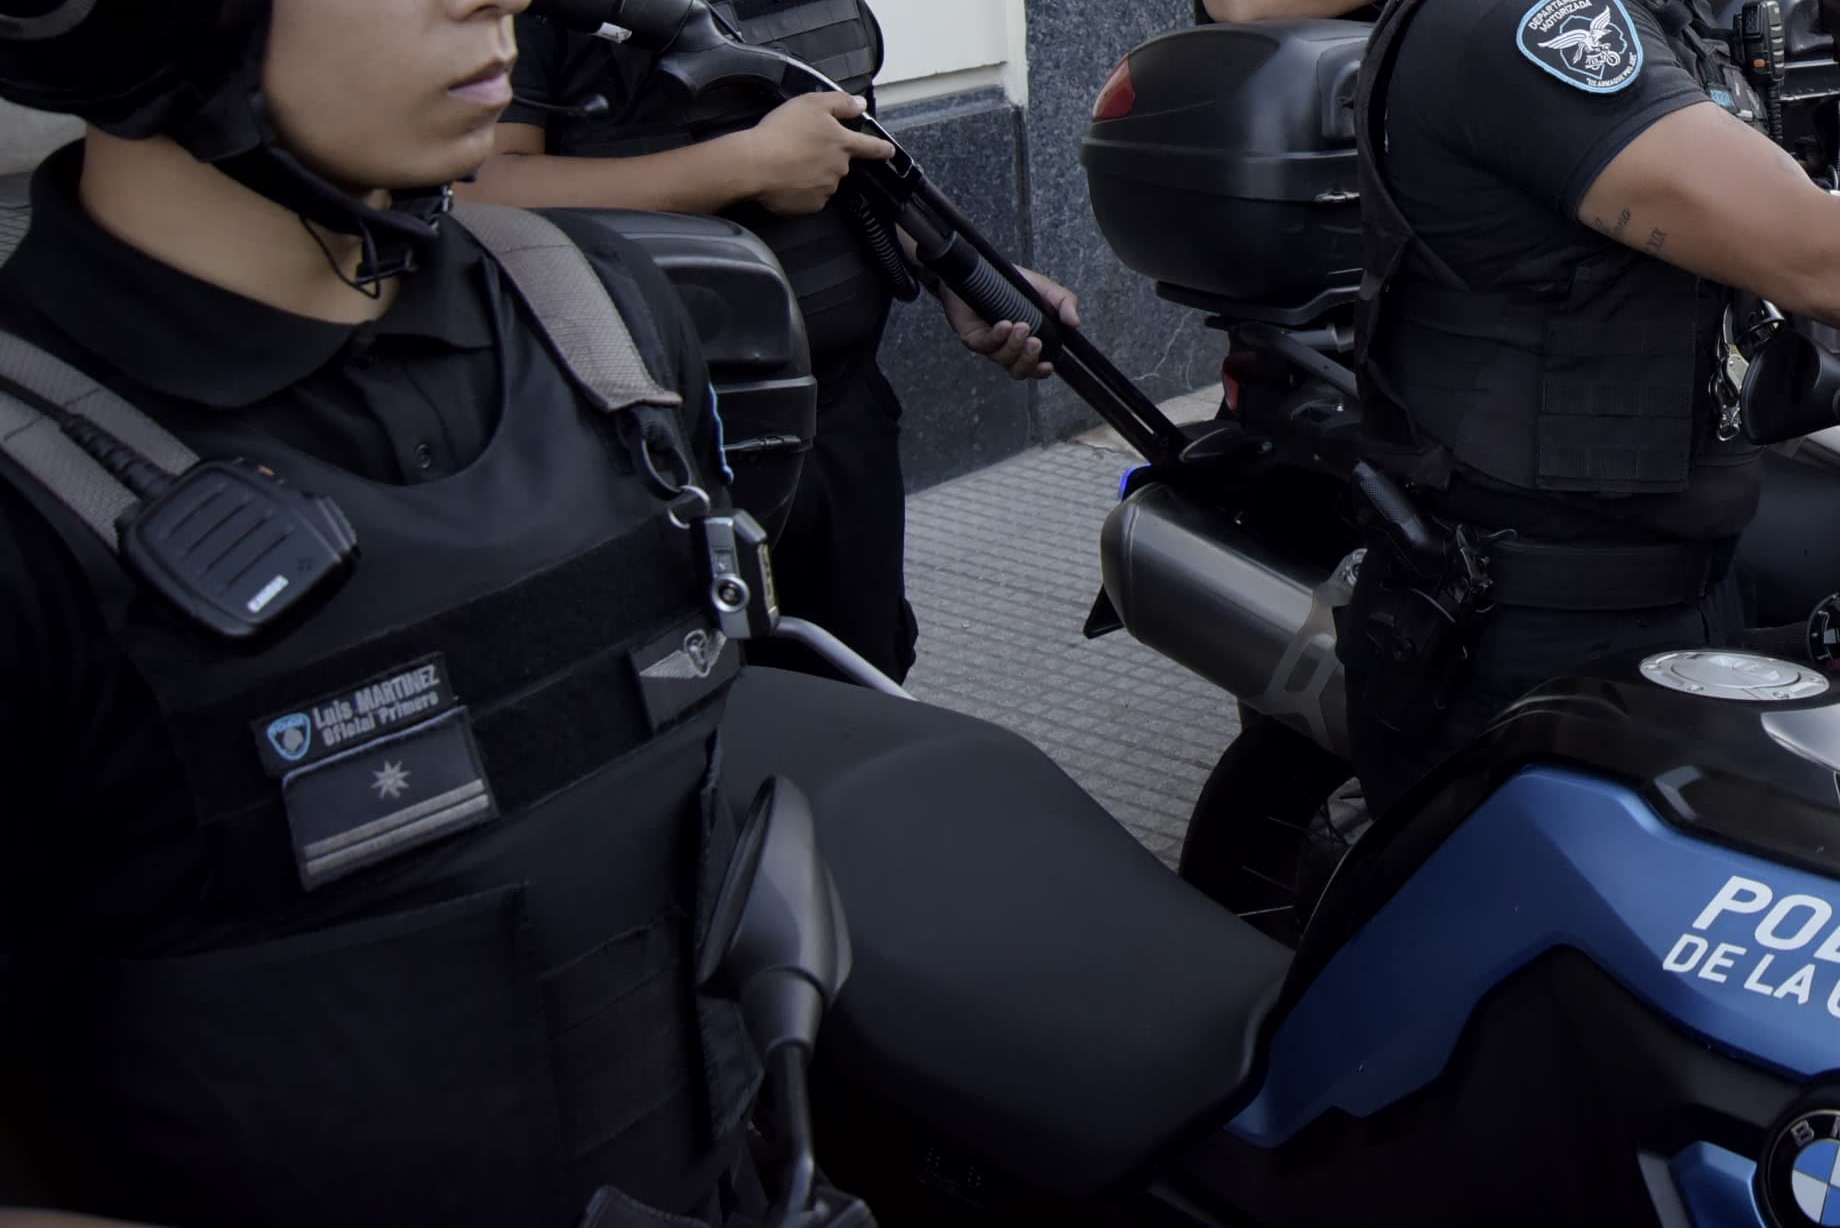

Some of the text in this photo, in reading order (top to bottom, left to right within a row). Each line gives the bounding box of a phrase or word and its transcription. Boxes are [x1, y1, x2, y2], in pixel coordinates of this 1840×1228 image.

[312, 664, 440, 730] Luis MARTINEZ
[321, 691, 439, 747] Oficial Primero
[1662, 933, 1747, 983] DE
[1743, 953, 1815, 1005] LA
